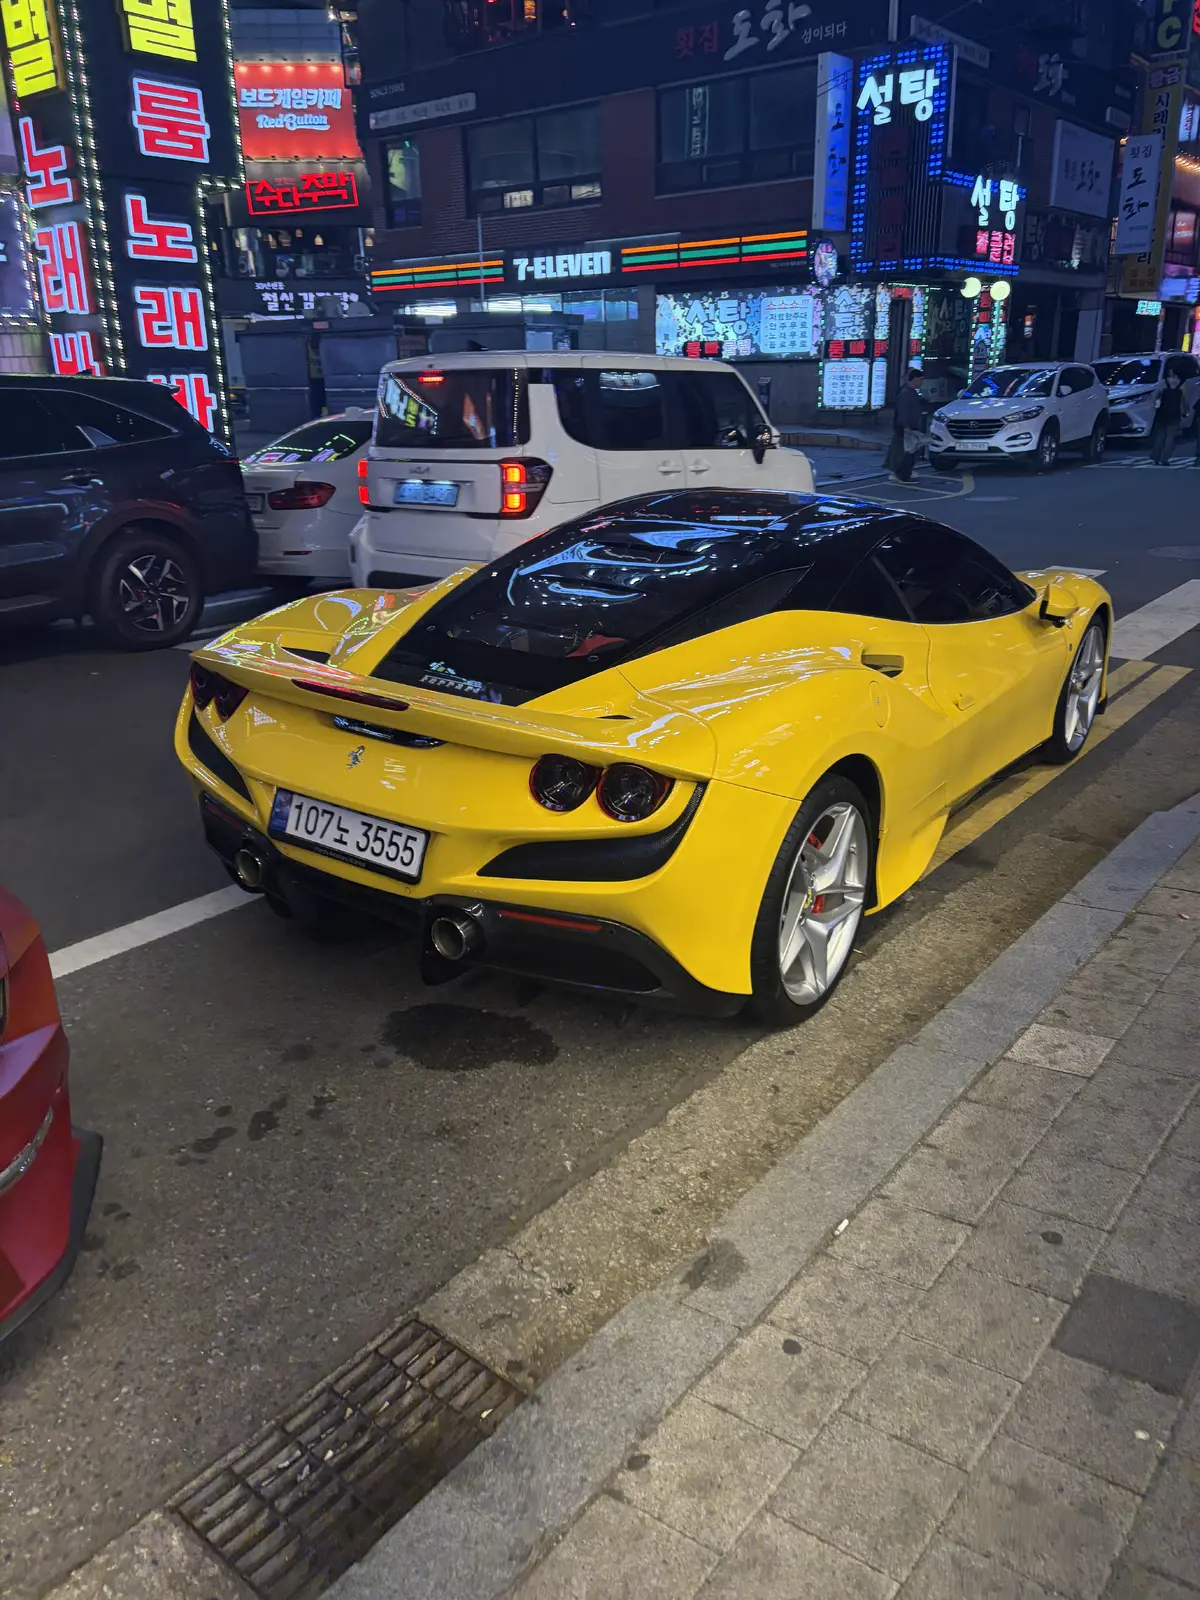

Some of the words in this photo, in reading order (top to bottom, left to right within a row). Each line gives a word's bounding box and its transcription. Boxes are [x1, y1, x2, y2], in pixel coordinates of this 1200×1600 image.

[801, 21, 847, 44] 섬이되다
[240, 88, 342, 109] 보드게임카페
[856, 69, 940, 126] 설탕
[970, 175, 1020, 231] 설탕
[686, 299, 750, 337] 설탕
[355, 820, 418, 867] 3555
